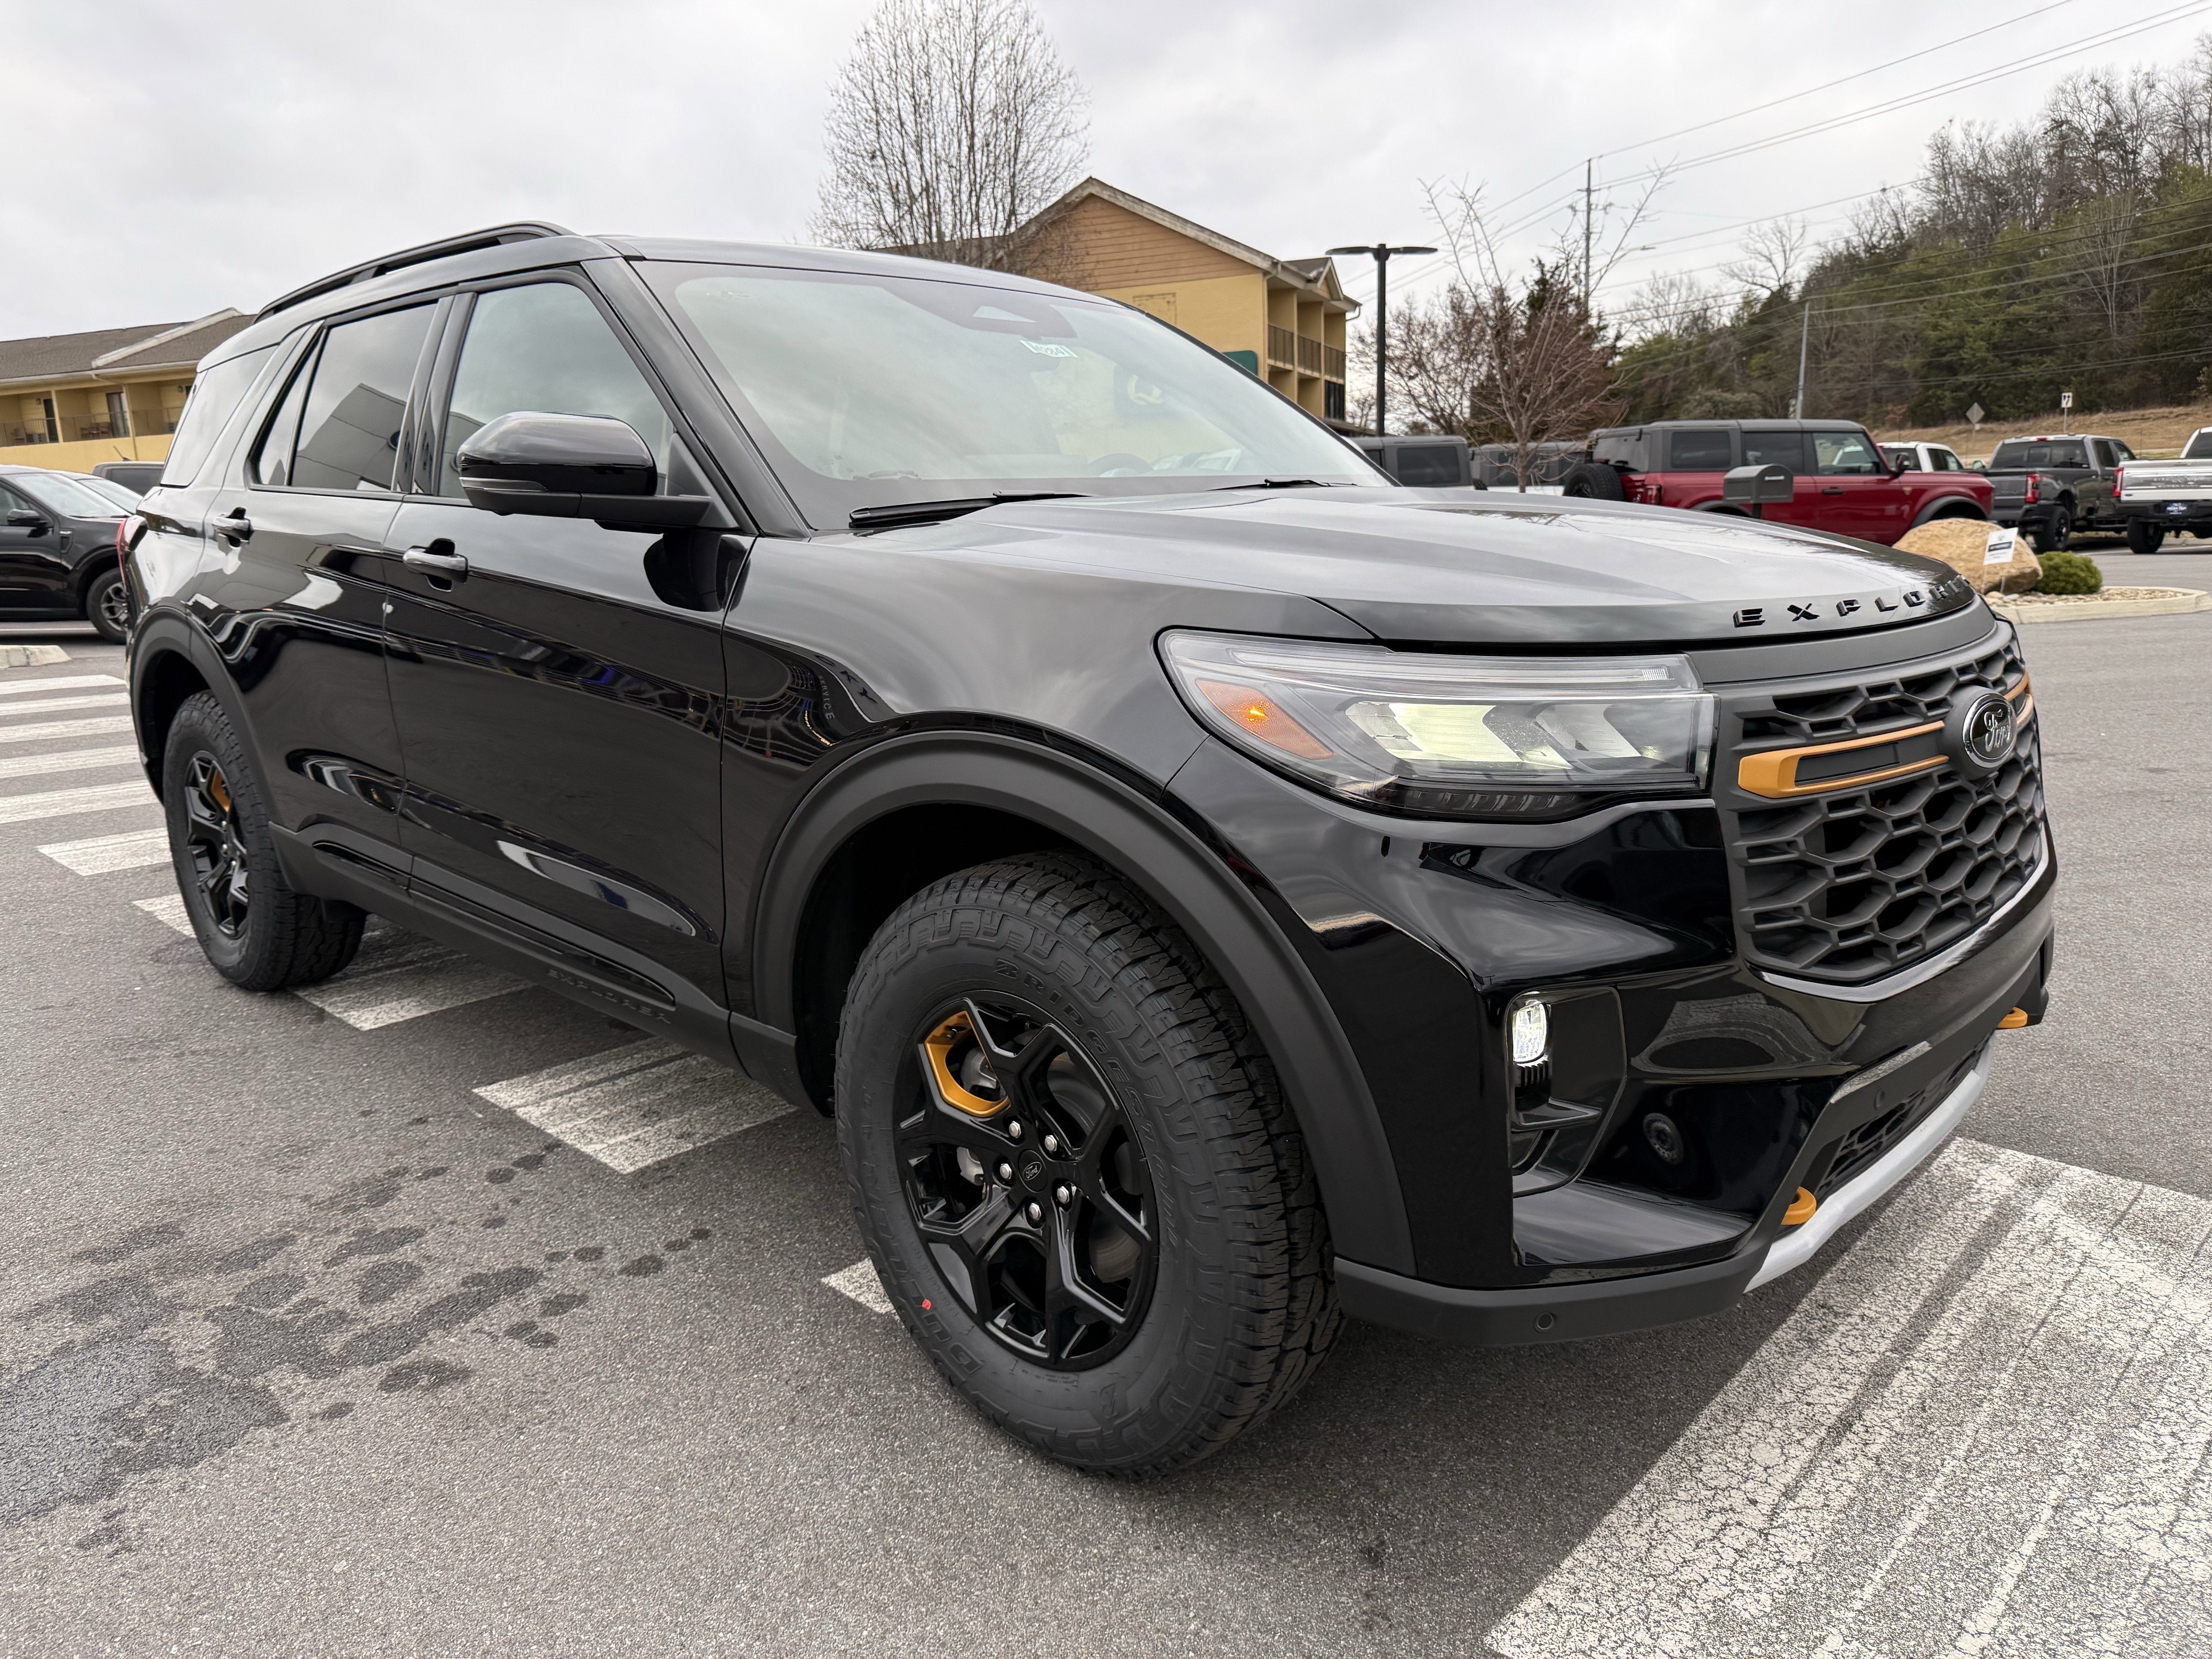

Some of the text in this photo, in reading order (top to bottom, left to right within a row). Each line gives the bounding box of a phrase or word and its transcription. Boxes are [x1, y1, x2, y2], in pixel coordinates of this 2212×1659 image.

[1984, 708, 2013, 752] Ford
[546, 969, 672, 1025] EXPLORER
[993, 958, 1181, 1248] BRIDGESTONE
[1025, 1164, 1039, 1179] Ford
